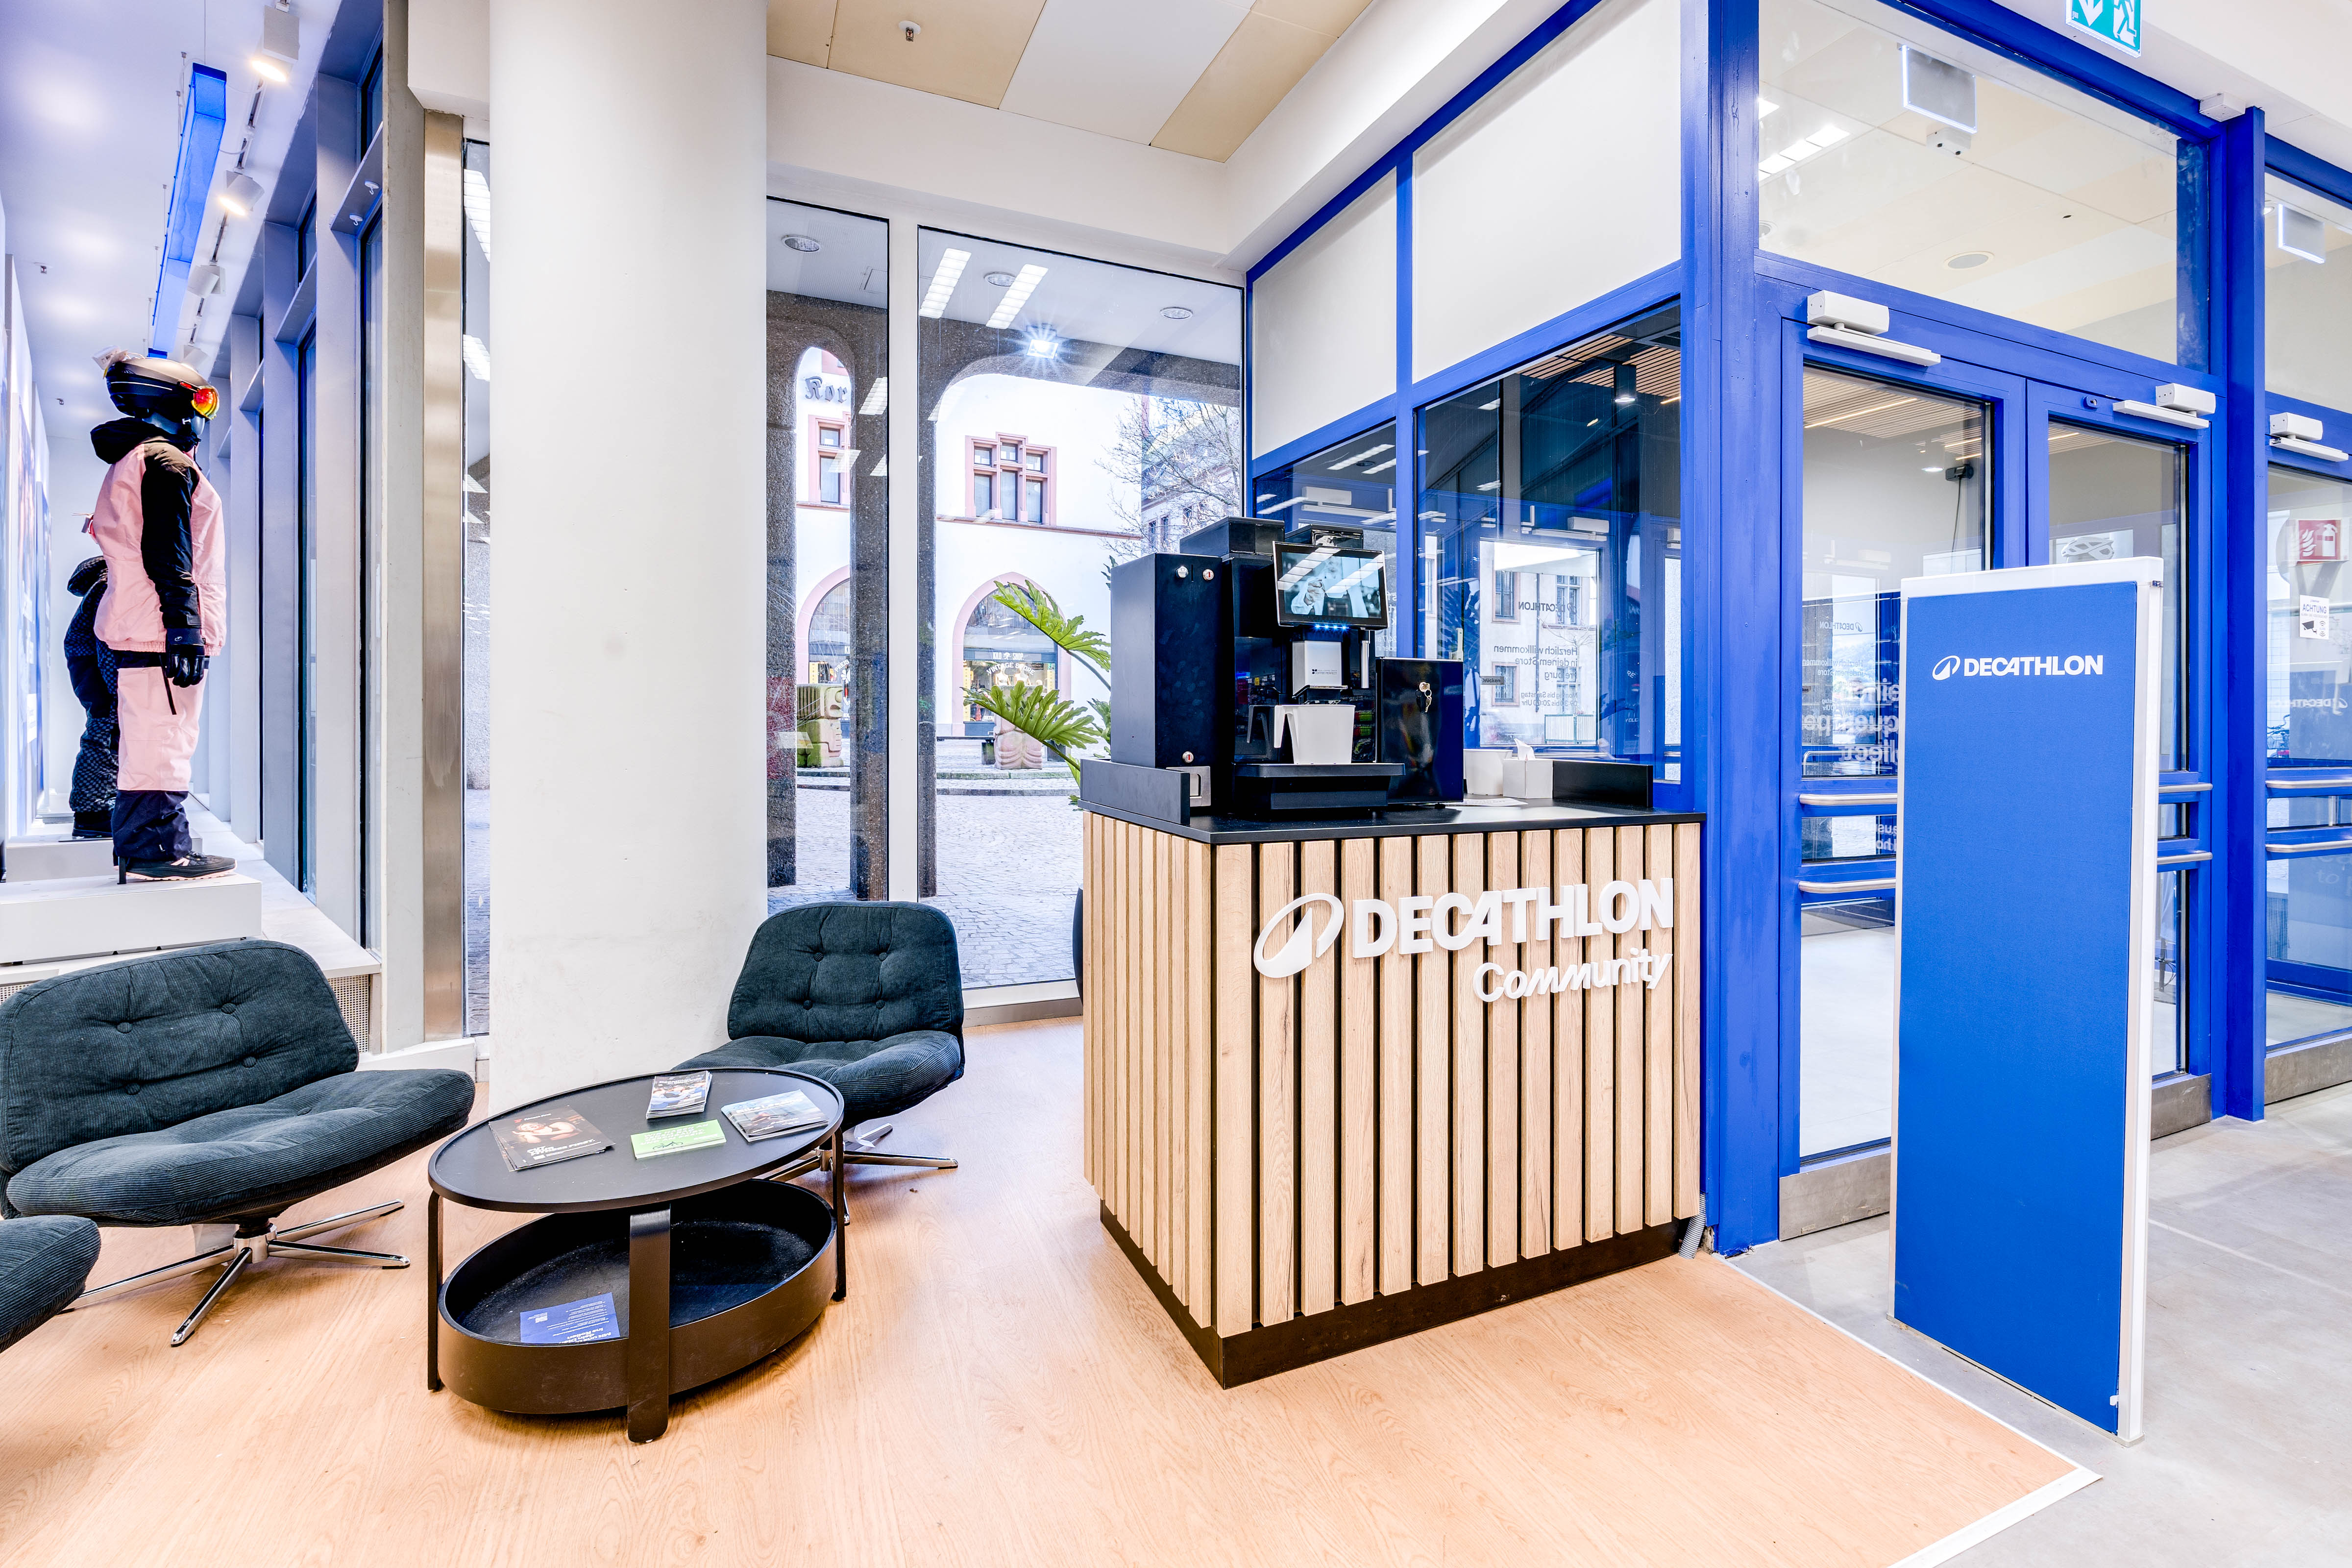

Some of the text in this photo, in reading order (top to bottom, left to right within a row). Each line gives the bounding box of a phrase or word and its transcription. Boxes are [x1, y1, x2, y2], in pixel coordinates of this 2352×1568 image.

[2303, 604, 2327, 613] ACHTUNG
[986, 662, 1014, 674] VINTGE
[1015, 662, 1035, 676] SORE
[1964, 655, 2104, 677] DECATHLON
[1353, 878, 1673, 958] DECATHLON
[1473, 947, 1673, 1003] Community
